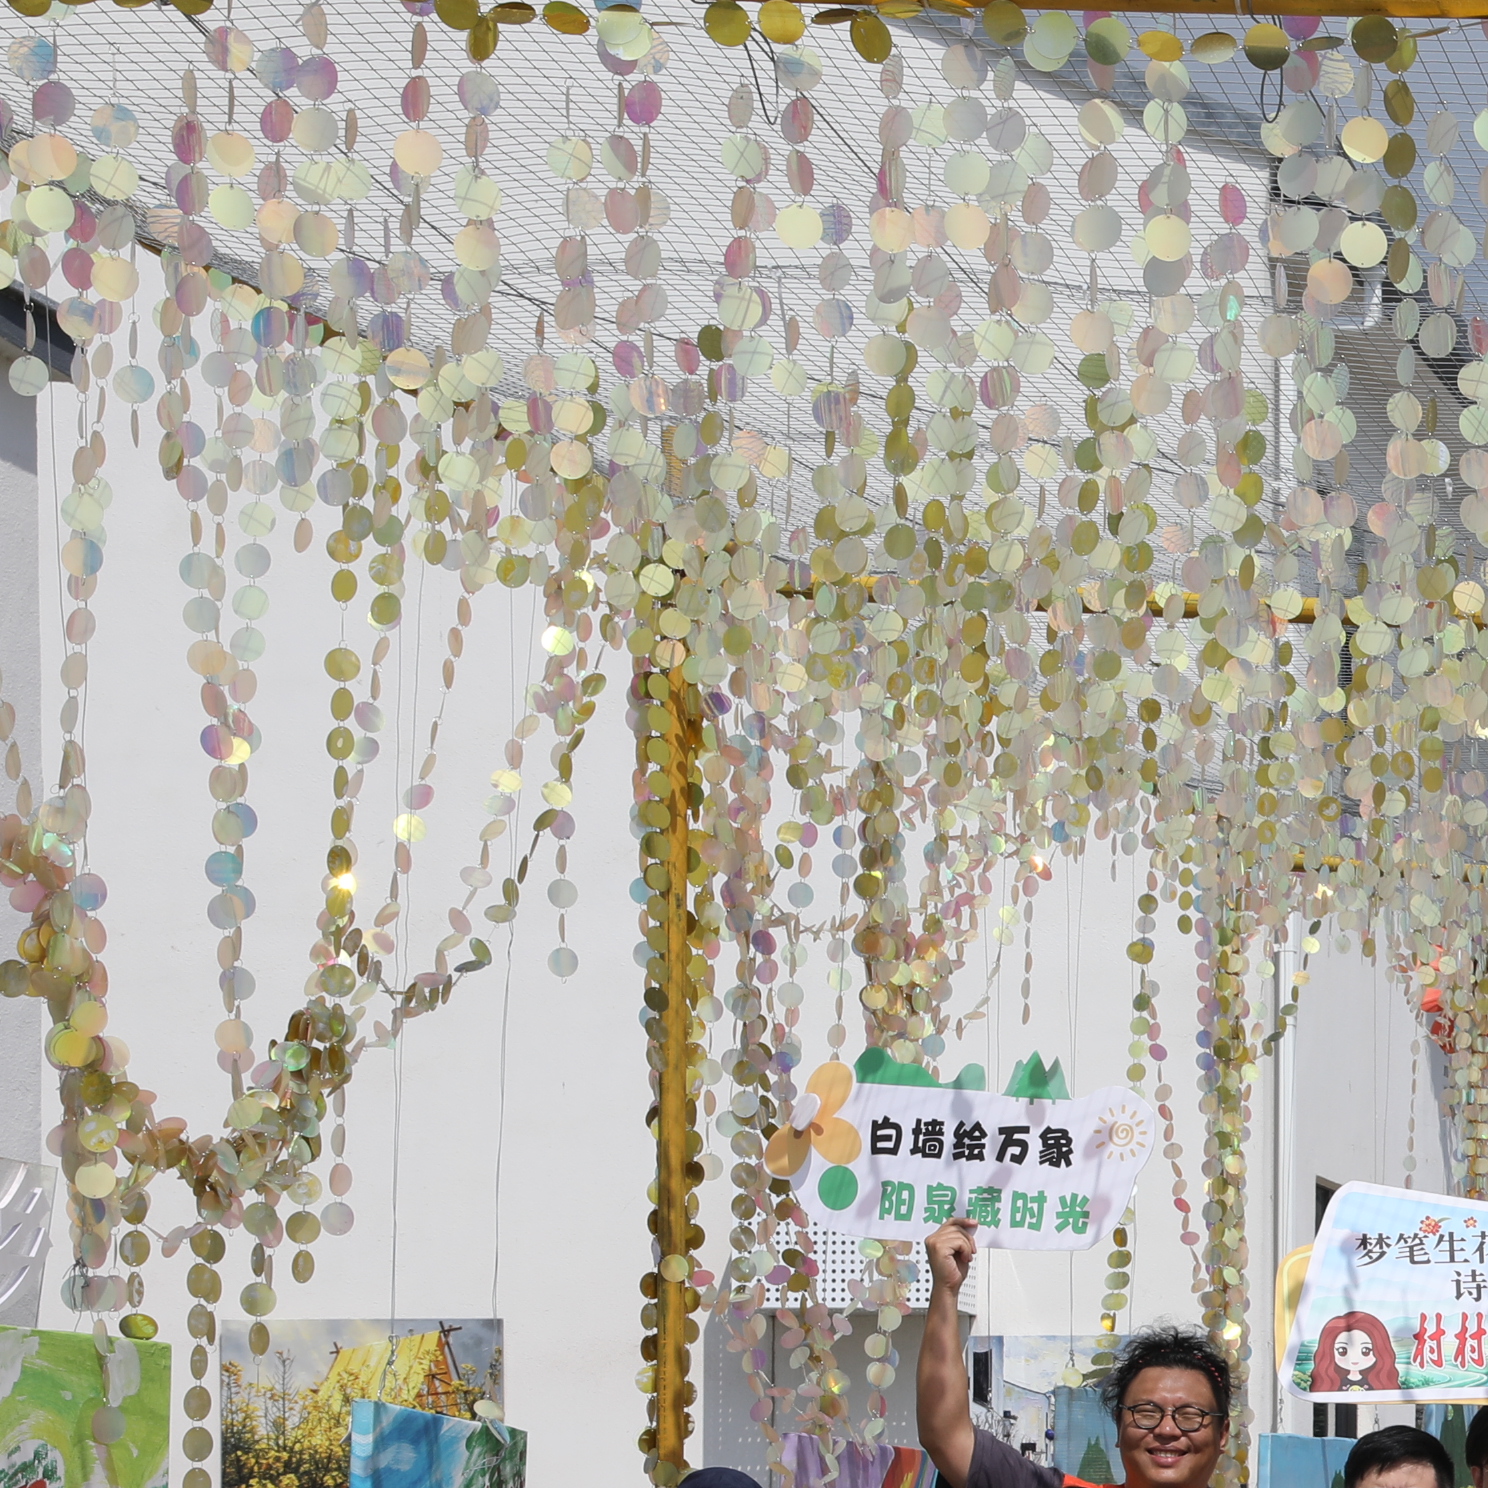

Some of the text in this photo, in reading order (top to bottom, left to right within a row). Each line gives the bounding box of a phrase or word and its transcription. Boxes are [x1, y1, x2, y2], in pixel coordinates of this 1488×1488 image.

[869, 1115, 1075, 1168] 白墙绘万象
[878, 1179, 1091, 1235] 阳泉藏时光
